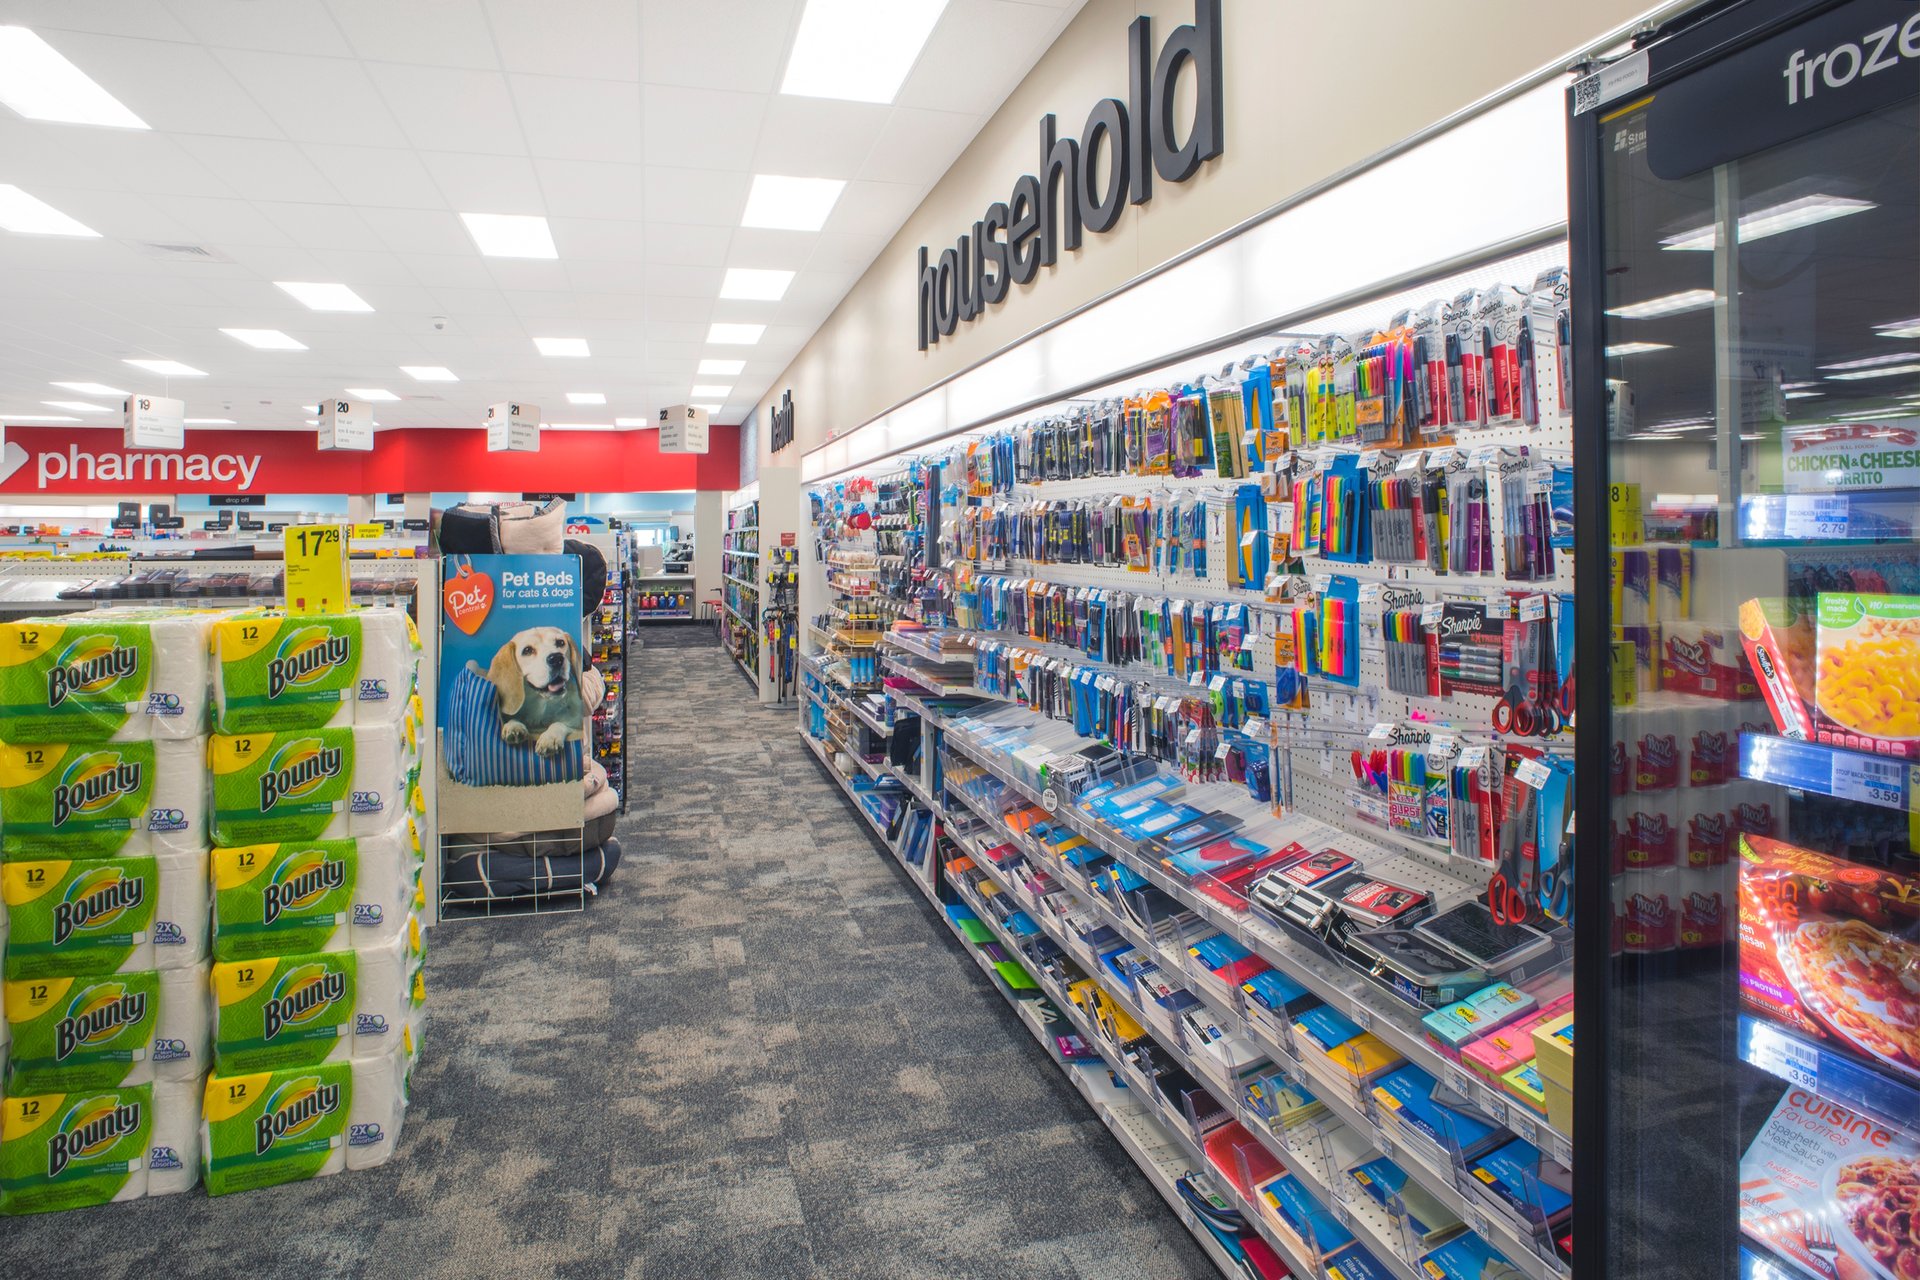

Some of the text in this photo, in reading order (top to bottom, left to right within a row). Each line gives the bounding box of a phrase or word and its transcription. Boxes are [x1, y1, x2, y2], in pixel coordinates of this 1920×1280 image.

[918, 0, 1224, 351] household
[1442, 308, 1470, 326] Sharpie
[138, 399, 150, 410] 19
[338, 402, 348, 413] 20
[511, 404, 520, 416] 21
[660, 410, 668, 420] 22
[688, 408, 696, 418] 22
[38, 444, 262, 490] pharmacy
[1368, 459, 1400, 480] Sharp
[1500, 456, 1530, 481] Sharpie
[1787, 454, 1850, 472] CHICKEN
[1850, 458, 1859, 467] &
[1818, 524, 1846, 534] $2.79
[502, 572, 574, 586] Pet Beds
[502, 588, 574, 598] for cats & dogs
[449, 585, 488, 618] Pet
[1382, 588, 1424, 613] Sharpie
[1825, 596, 1850, 606] freshly
[458, 604, 480, 616] central
[1441, 612, 1482, 638] Sharpie
[20, 632, 39, 644] 12
[242, 626, 258, 640] 12
[268, 635, 350, 700] Bounty
[48, 646, 138, 708] Bounty
[361, 680, 376, 691] 2X
[151, 694, 166, 705] 2X
[1387, 728, 1431, 748] Sharpie
[235, 740, 250, 752] 12
[26, 750, 44, 764] 12
[260, 747, 342, 813] Bounty
[53, 761, 142, 828] Bounty
[353, 792, 367, 803] 2X
[1868, 788, 1898, 802] $3.59
[152, 810, 169, 821] 2X
[1392, 804, 1421, 818] BURST
[238, 853, 254, 866] 12
[27, 868, 45, 882] 12
[263, 860, 346, 926] Bounty
[52, 877, 144, 946] Bounty
[355, 905, 370, 916] 2X
[157, 923, 172, 934] 2X
[238, 969, 254, 982] 12
[31, 986, 48, 1000] 12
[1750, 978, 1782, 998] PROTEIN
[263, 972, 346, 1041] Bounty
[56, 992, 146, 1061] Bounty
[358, 1014, 374, 1025] 2X
[156, 1040, 172, 1050] 2X
[1788, 1070, 1816, 1088] $3.99
[230, 1084, 246, 1098] 12
[22, 1102, 40, 1116] 12
[255, 1084, 340, 1156] Bounty
[1788, 1090, 1891, 1148] cuisine
[352, 1125, 368, 1136] 2X
[1773, 1106, 1850, 1148] favorites
[49, 1103, 140, 1178] Bounty
[1770, 1120, 1838, 1161] Spaghetti with
[154, 1148, 168, 1159] 2X
[1764, 1130, 1825, 1167] Meat Sauce
[1343, 1258, 1357, 1274] Filler
